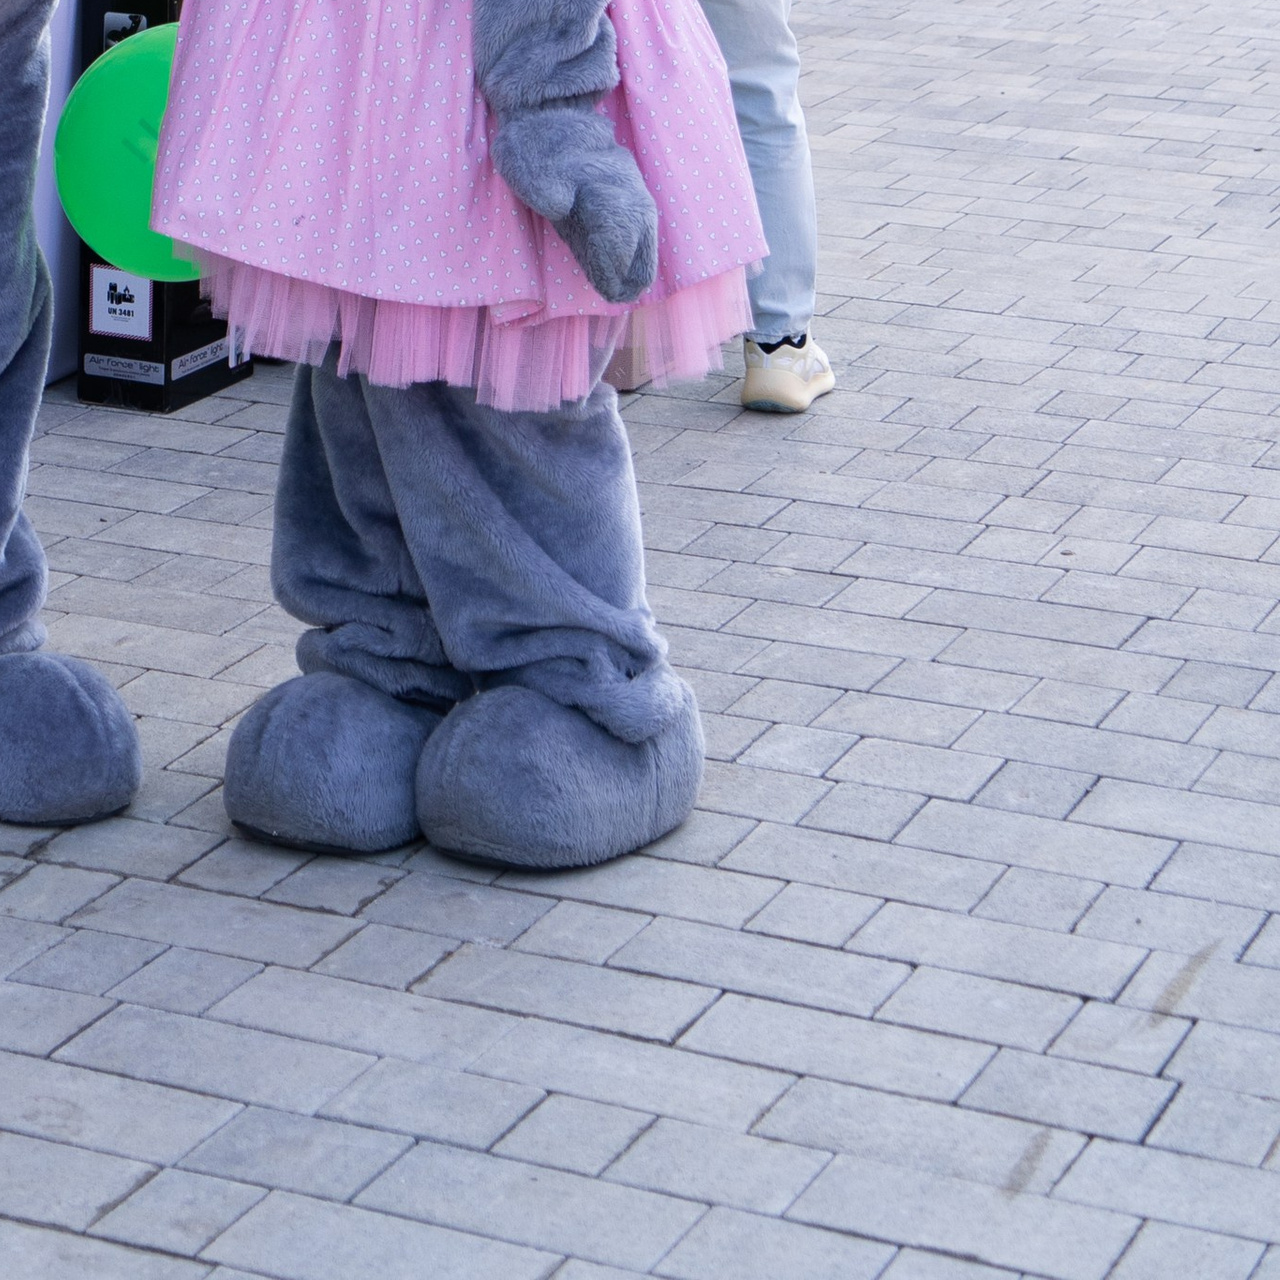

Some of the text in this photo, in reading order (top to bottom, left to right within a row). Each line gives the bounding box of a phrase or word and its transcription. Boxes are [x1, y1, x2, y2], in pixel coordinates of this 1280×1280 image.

[107, 307, 135, 318] UN 3481
[89, 356, 105, 365] Air
